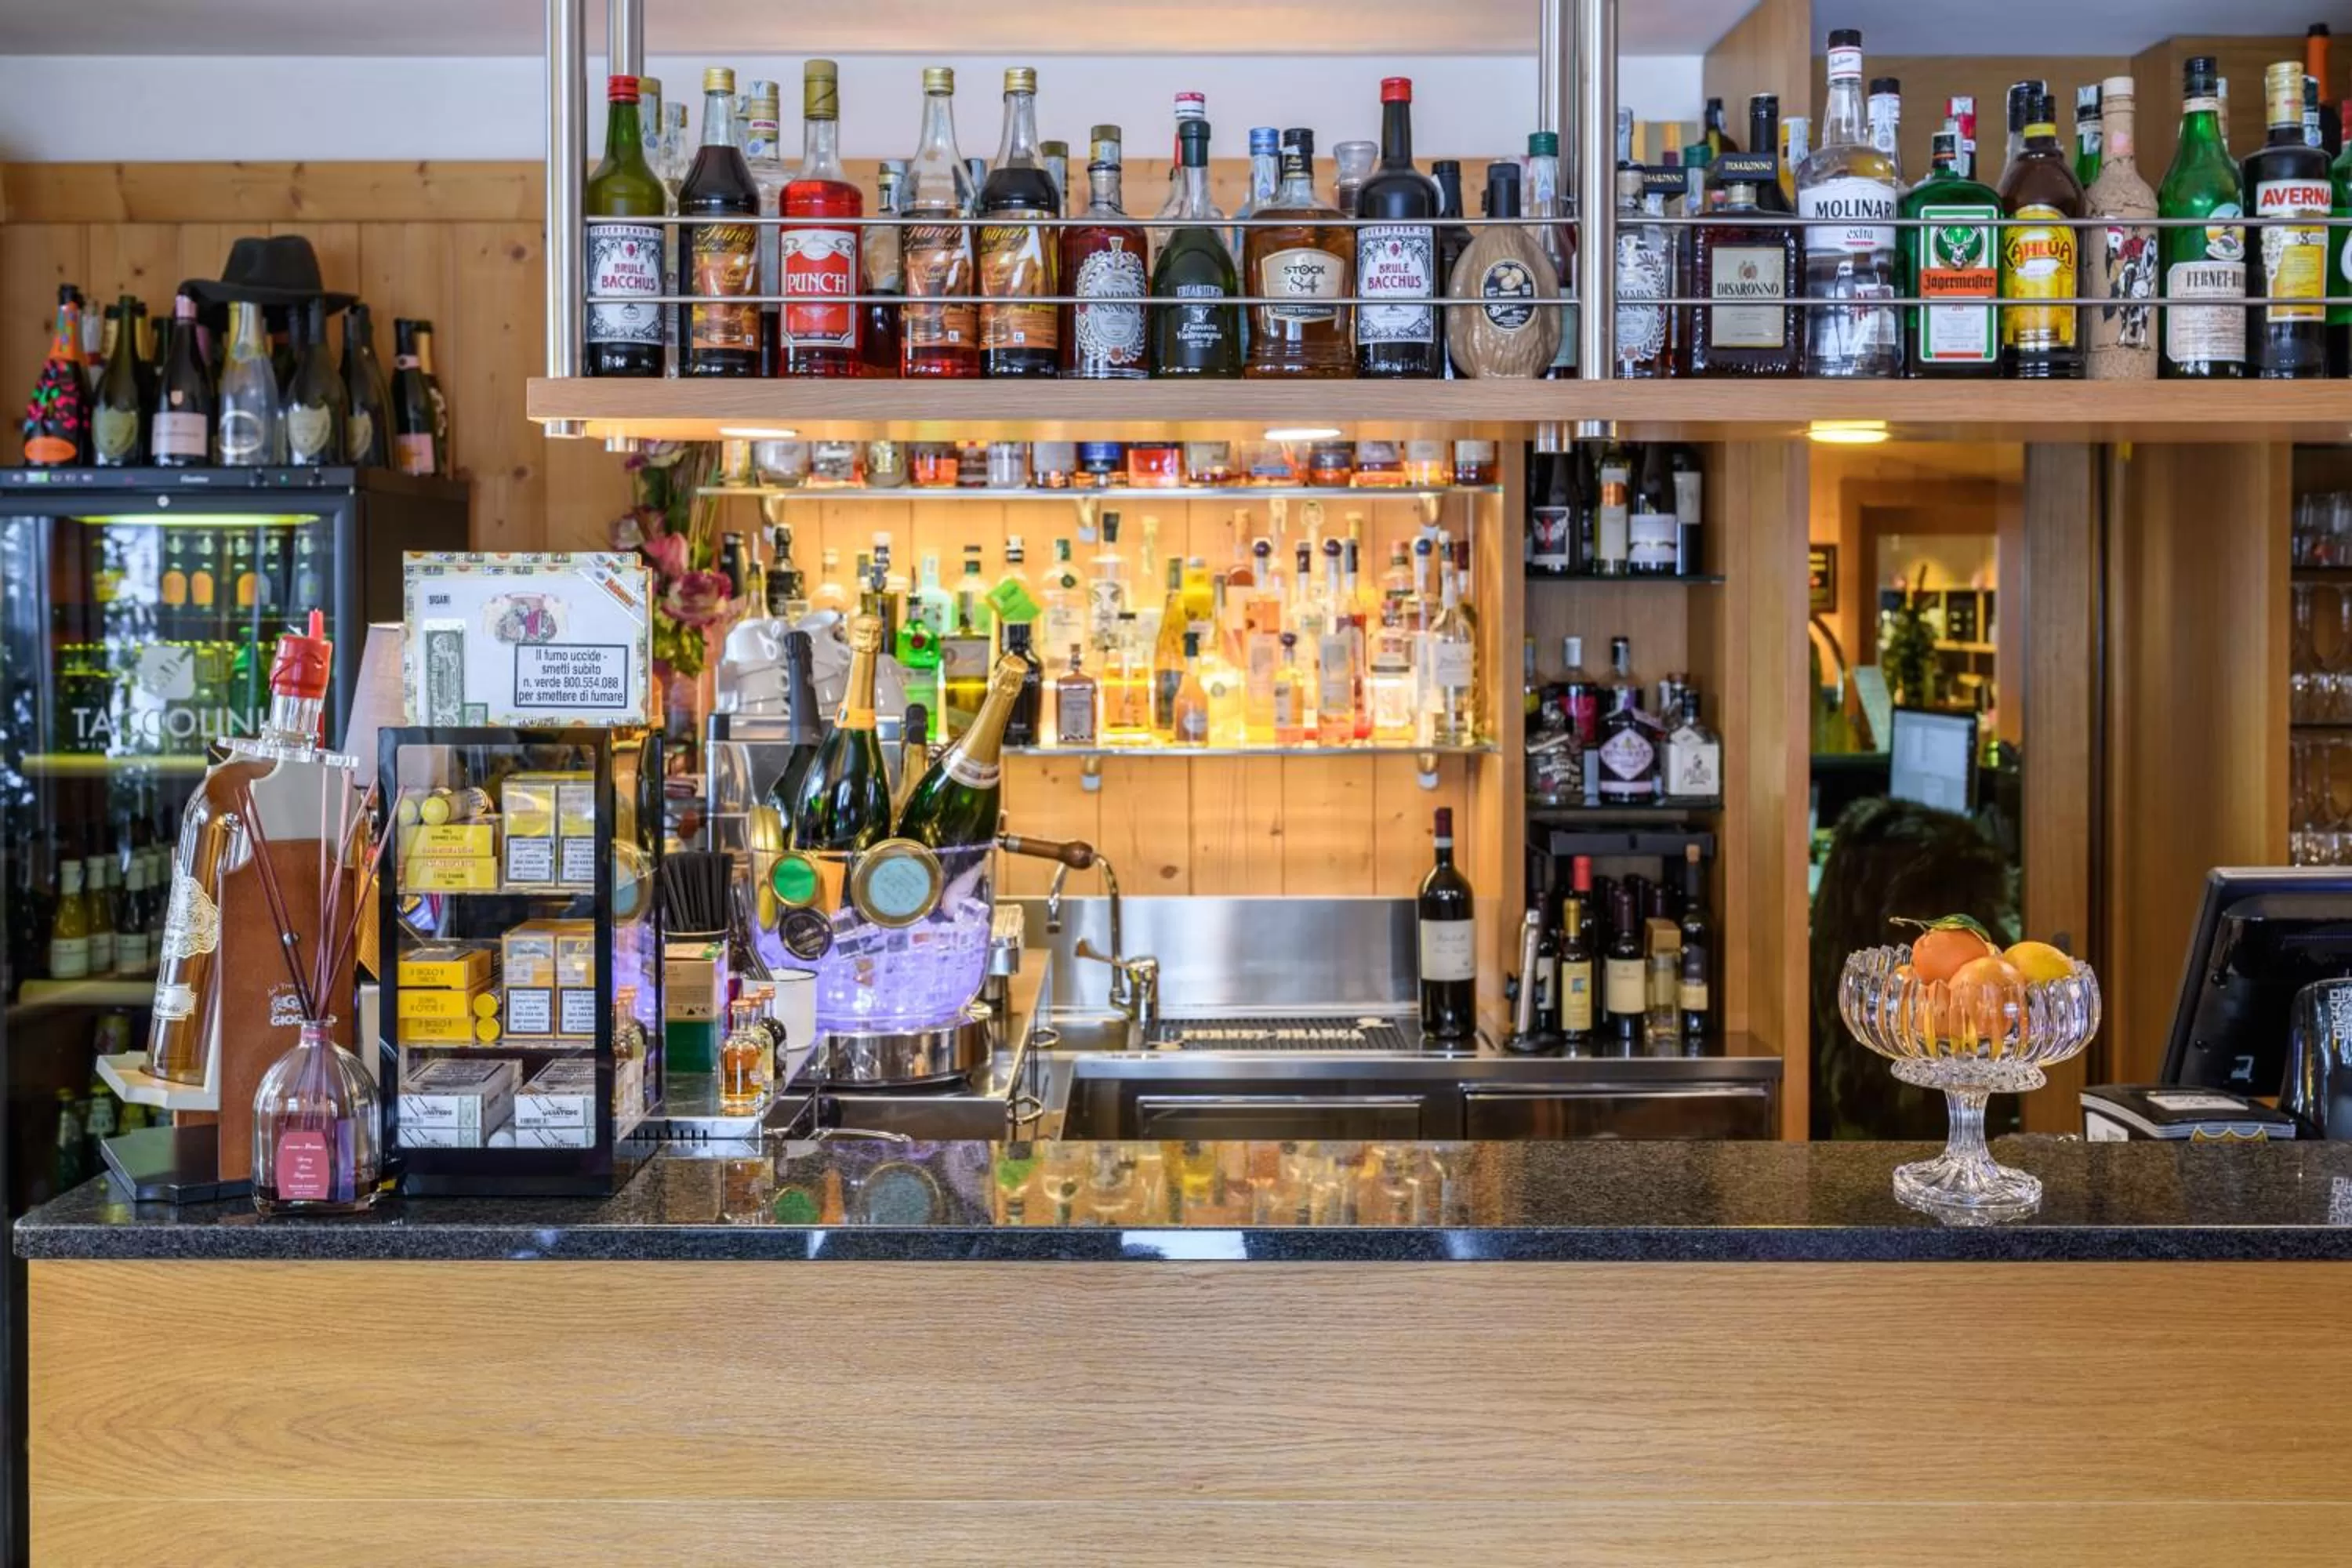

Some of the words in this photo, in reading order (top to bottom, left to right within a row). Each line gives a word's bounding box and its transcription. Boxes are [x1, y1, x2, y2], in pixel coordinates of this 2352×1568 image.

[1726, 160, 1773, 171] DISARONNO
[2261, 187, 2332, 207] AVERNA
[1815, 198, 1895, 220] MOLINARI
[1846, 228, 1874, 239] extra
[2004, 236, 2074, 274] KAHLÚA
[614, 263, 645, 275] BRULE
[1283, 264, 1326, 275] STOCK
[1378, 263, 1410, 274] BRULE
[601, 275, 656, 291] BACCHUS
[786, 272, 848, 293] PUNCH
[1288, 275, 1320, 294] 84
[1367, 275, 1422, 290] BACCHUS
[1717, 281, 1779, 296] DISARONNO
[535, 648, 542, 660] Il
[544, 648, 568, 661] fumo
[570, 648, 601, 661] uccide
[542, 662, 570, 675] smetti
[572, 662, 601, 675] subito
[523, 677, 532, 688] n.
[535, 676, 561, 688] verde
[563, 677, 619, 688] 800.554.088
[518, 691, 534, 705] per
[536, 690, 578, 702] smettere
[579, 690, 589, 702] di
[590, 690, 623, 702] fumare
